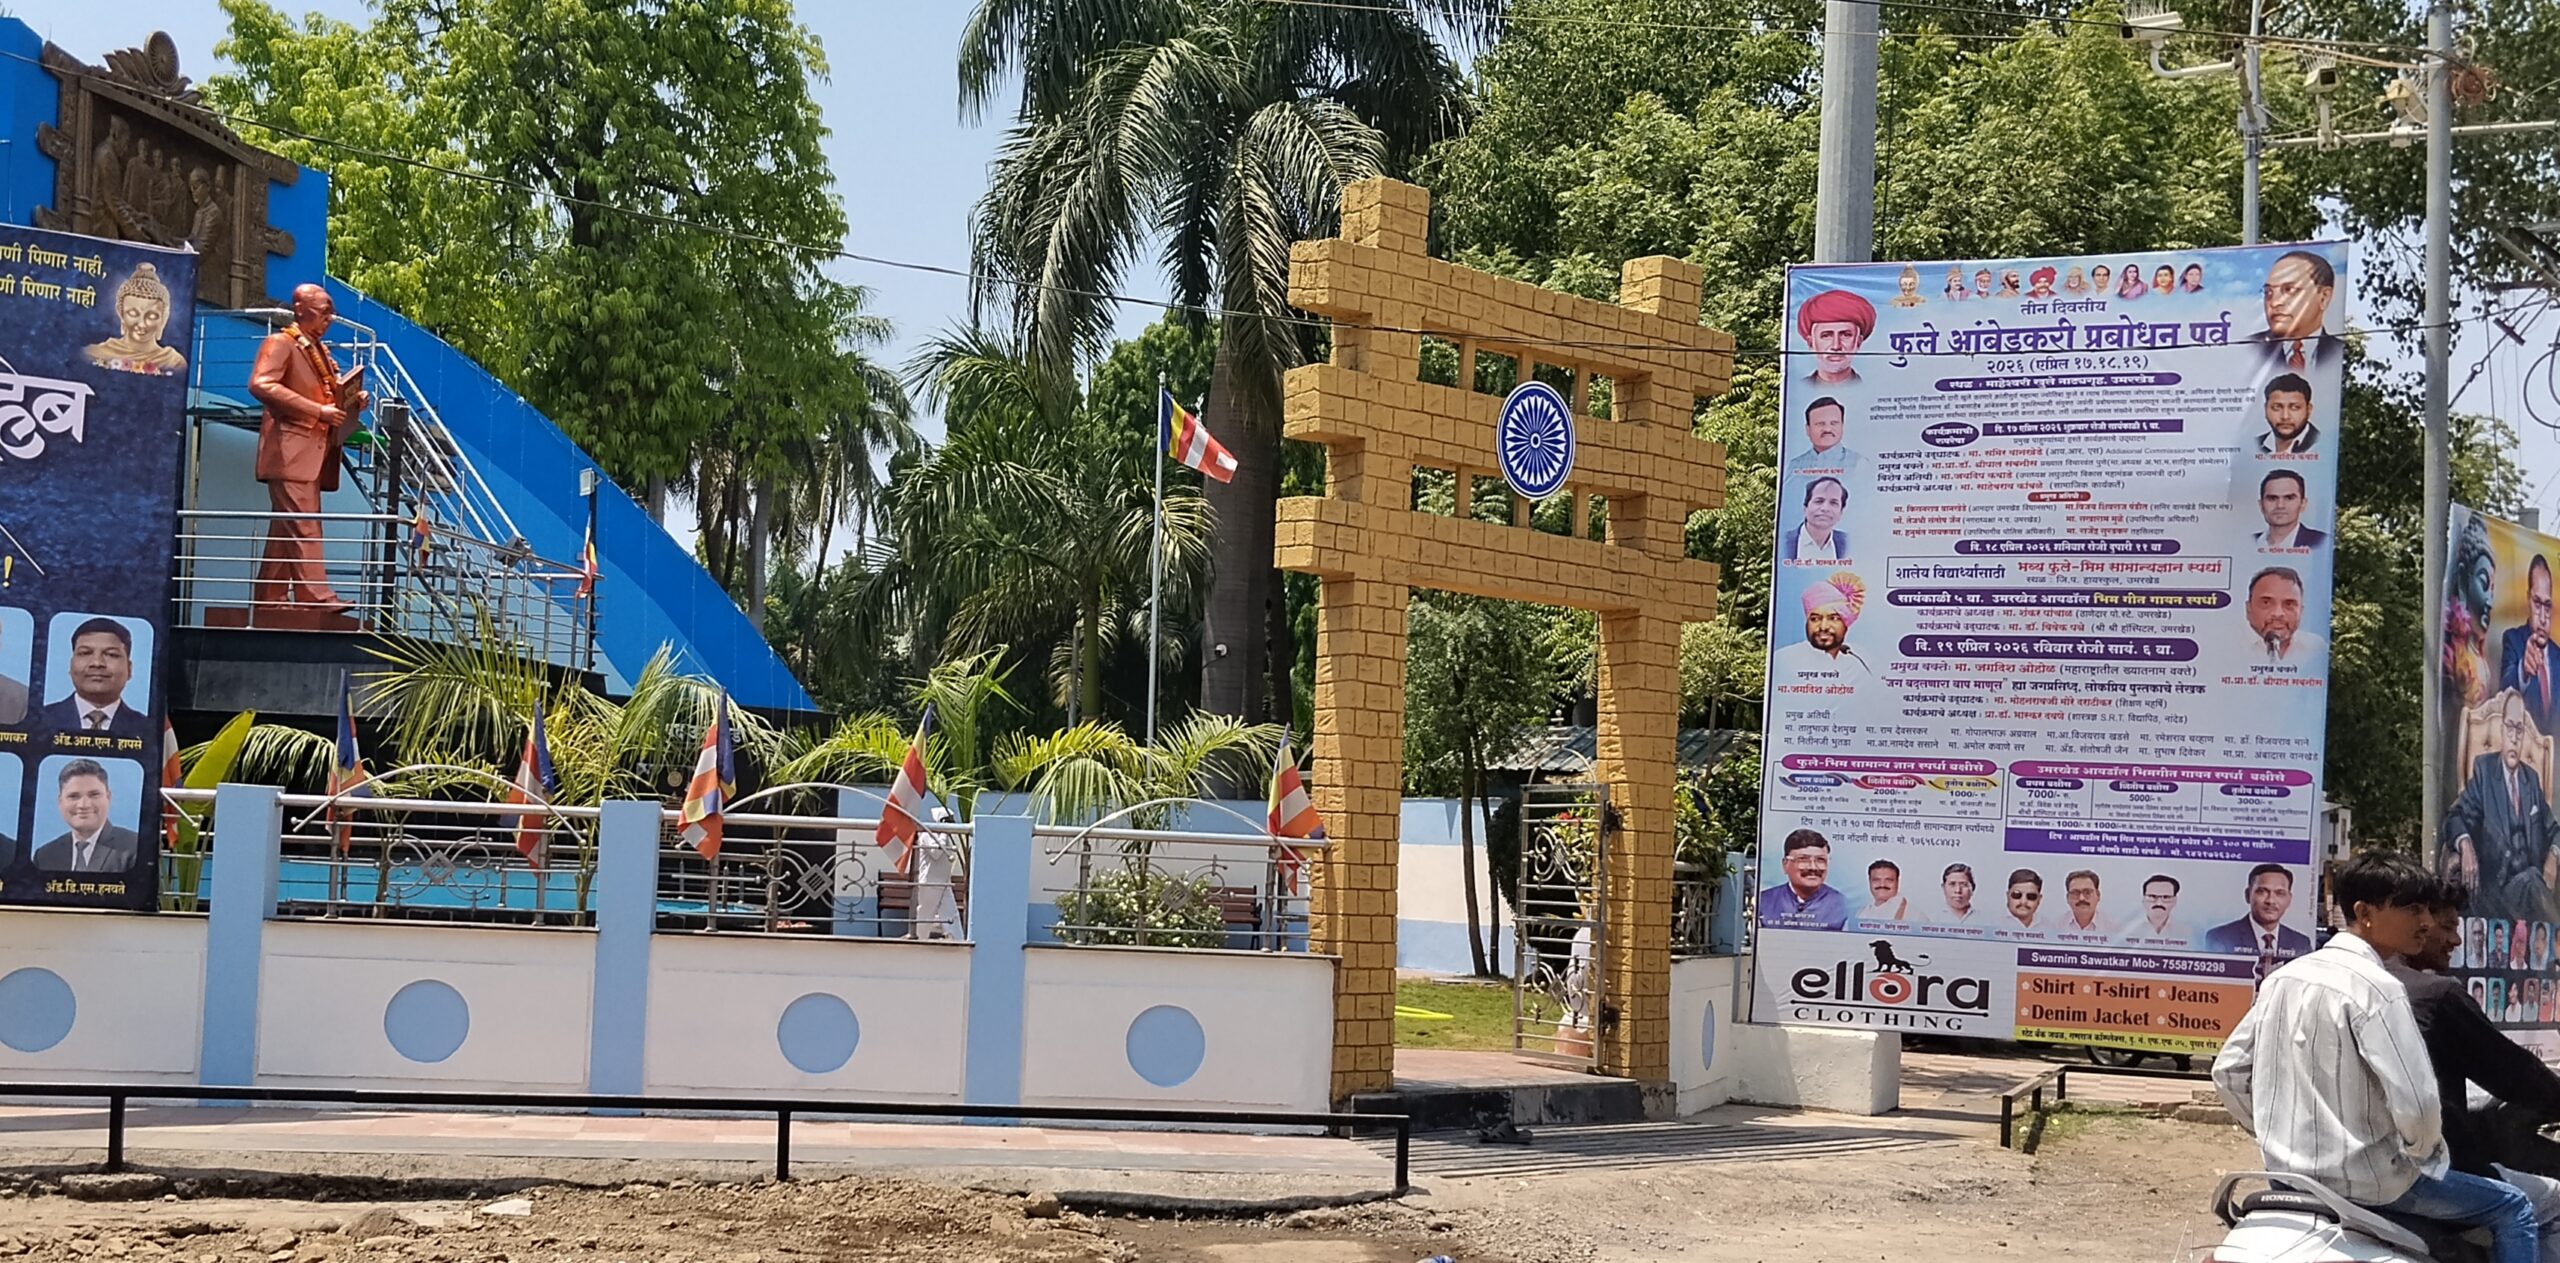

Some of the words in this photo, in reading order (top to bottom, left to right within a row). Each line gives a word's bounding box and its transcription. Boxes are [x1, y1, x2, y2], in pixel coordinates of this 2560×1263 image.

[28, 243, 68, 269] पिणार
[73, 255, 107, 279] नाही,
[21, 276, 61, 301] पिणार
[66, 286, 96, 308] नाही
[2020, 301, 2047, 315] तीन
[2052, 299, 2106, 315] दिवसीय
[1888, 321, 1940, 369] फुले
[1948, 317, 2076, 355] आंबेडकरी
[2083, 314, 2181, 350] प्रबोधन
[2188, 311, 2232, 346] पर्व
[1987, 359, 2025, 374] २०२६
[2030, 358, 2069, 373] (एप्रिल
[2073, 354, 2149, 371] १७.१८.१९)
[1949, 380, 1973, 390] स्थळ
[1986, 376, 2030, 390] माहेश्वरी
[2034, 376, 2054, 390] खुले
[2111, 374, 2155, 387] उमरखेड
[0, 355, 95, 459] हेब
[1970, 542, 1982, 551] दि.
[1999, 542, 2023, 552] एप्रिल
[2026, 543, 2051, 551] २०२६
[2053, 542, 2086, 551] शनिवार
[2087, 541, 2107, 551] रोजी
[1896, 565, 1929, 579] शालेय
[2018, 562, 2044, 572] भव्य
[2049, 560, 2104, 575] फुले-भिम
[2109, 561, 2183, 572] सामान्यज्ञान
[2188, 560, 2222, 573] स्पर्धा
[1897, 593, 1951, 603] सायंकाळी
[1992, 592, 2037, 603] उमरखेड
[2040, 594, 2090, 604] आयडॉल
[2093, 594, 2118, 604] भिम
[2122, 594, 2146, 605] गीत
[2150, 596, 2182, 604] गायन
[2186, 594, 2218, 605] स्पर्धा
[1917, 609, 1961, 617] कार्यक्रमाचे
[1964, 609, 1995, 617] अध्यक्ष
[2137, 610, 2172, 619] उमरखेड)
[1916, 622, 1960, 630] कार्यक्रमाचे
[2025, 622, 2039, 631] डॉ.
[2042, 623, 2067, 631] विवेक
[2161, 624, 2195, 634] उमरखेड)
[1915, 640, 1931, 652] दि.
[1937, 642, 1952, 651] १९
[1957, 640, 1989, 653] एप्रिल
[1994, 642, 2029, 653] २०२६
[2033, 640, 2073, 653] रविवार
[2076, 641, 2104, 654] रोजी
[2108, 641, 2138, 655] सायं.
[2143, 645, 2151, 656] ६
[2155, 645, 2175, 655] वा.
[1890, 663, 1919, 674] प्रमुख
[1955, 663, 1970, 672] मा.
[1975, 662, 2016, 673] जगदिश
[2019, 664, 2056, 673] ओहोळ
[2060, 664, 2119, 676] (महाराष्ट्रातील
[2123, 667, 2166, 676] ख्यातनाम
[2170, 666, 2196, 677] वक्ते)
[1825, 685, 1855, 694] ओहोळ
[1906, 680, 1950, 690] बदलणारा
[1953, 680, 1970, 689] बाप
[2085, 681, 2127, 693] लोकप्रिय
[2130, 682, 2172, 696] पुस्तकाचे
[2175, 683, 2207, 694] लेखक
[1902, 708, 1946, 717] कार्यक्रमाचे
[1948, 709, 1976, 718] अध्यक्ष
[1797, 758, 1849, 769] फुले-भिम
[1851, 760, 1890, 769] सामान्य
[1919, 760, 1946, 771] स्पर्धा
[2037, 766, 2080, 775] उमरखेड
[2083, 766, 2129, 776] आयडॉल
[2132, 766, 2177, 780] भिमगीत
[2181, 771, 2211, 779] गायन
[2215, 769, 2243, 781] स्पर्धा
[2028, 790, 2060, 798] 7000/-
[2031, 952, 2078, 964] Swarnim
[2080, 954, 2130, 967] Sawatkar
[2132, 957, 2160, 968] Mob-
[2163, 958, 2226, 973] 7558759298
[1791, 961, 1989, 1009] ellora
[2032, 978, 2076, 995] Shirt
[2092, 981, 2151, 999] T-shirt
[2168, 986, 2219, 1004] Jeans
[1794, 1007, 1963, 1030] CLOTHING
[2031, 1005, 2087, 1022] Denim
[2092, 1009, 2150, 1026] Jacket
[2167, 1012, 2221, 1030] Shoes
[2261, 1195, 2302, 1203] HONDA
